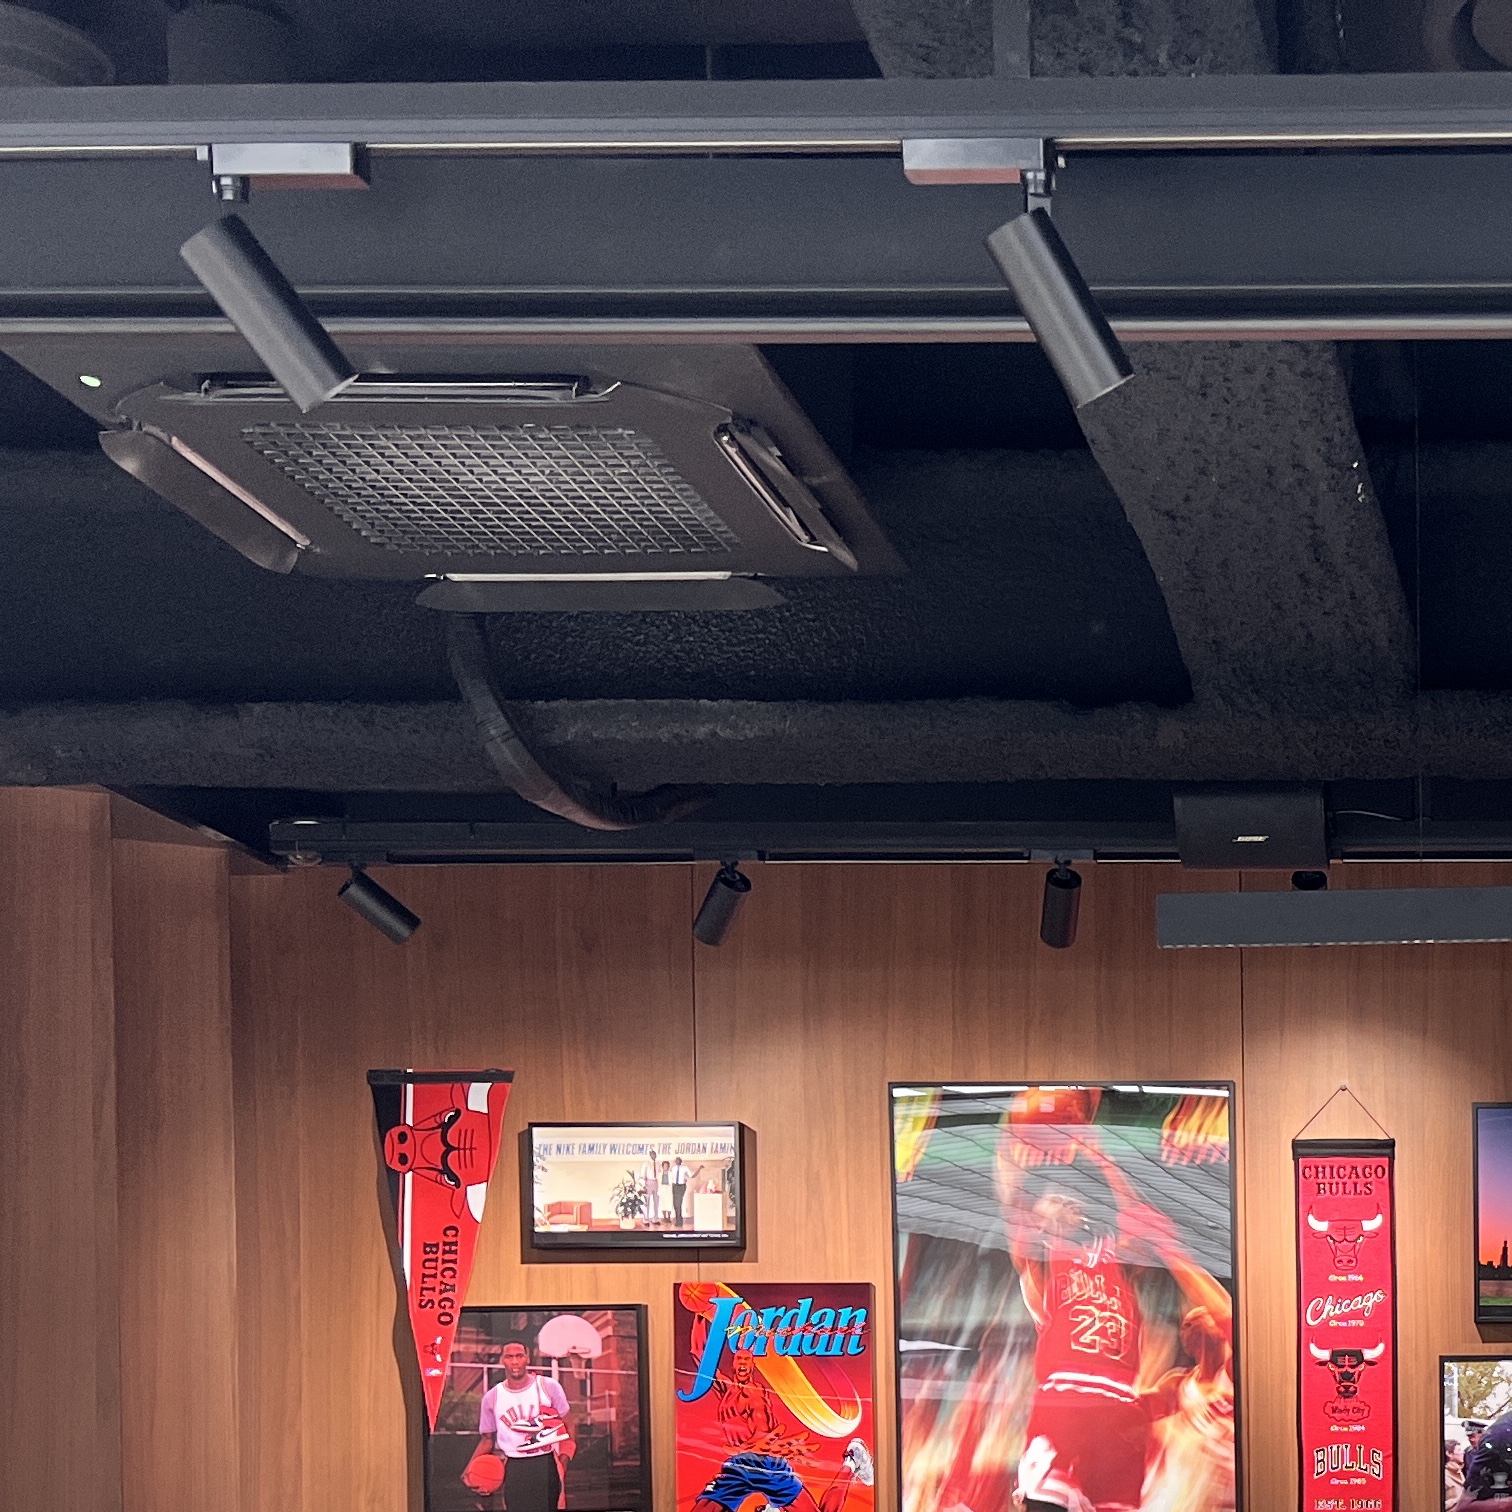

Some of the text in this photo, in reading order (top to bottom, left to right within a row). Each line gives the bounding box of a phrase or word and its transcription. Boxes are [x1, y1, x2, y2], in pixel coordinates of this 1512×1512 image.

[555, 1143, 575, 1156] NIKE
[578, 1142, 607, 1155] FAMILY
[657, 1142, 672, 1155] THE
[674, 1142, 708, 1155] JORDAN
[1301, 1164, 1387, 1180] CHICAGO
[1315, 1181, 1374, 1196] BULLS
[418, 1241, 440, 1310] BULLS
[437, 1225, 460, 1327] CHICAGO
[1305, 1288, 1387, 1327] Chicago
[677, 1297, 869, 1403] Jordan
[1068, 1305, 1129, 1361] 23
[1313, 1443, 1383, 1480] BULLS
